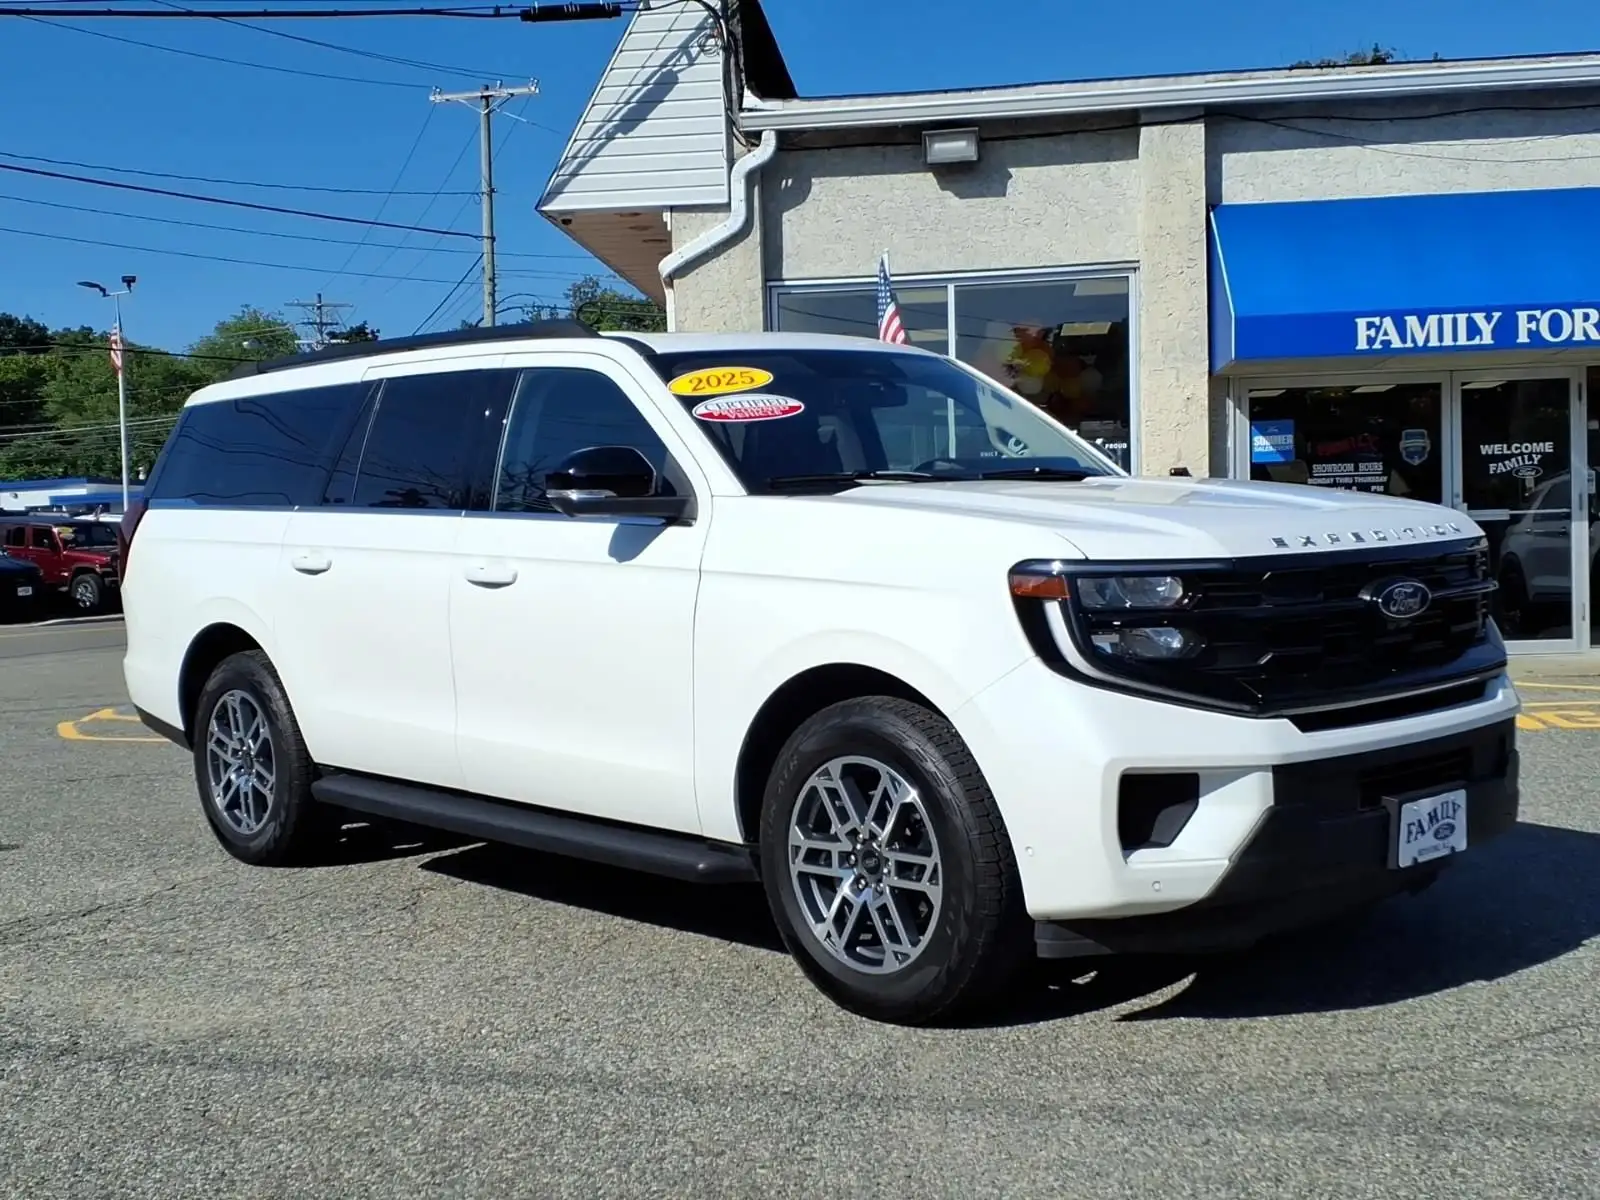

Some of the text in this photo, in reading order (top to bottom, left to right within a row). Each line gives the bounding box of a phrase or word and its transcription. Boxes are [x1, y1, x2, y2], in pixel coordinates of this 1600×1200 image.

[1354, 312, 1502, 350] FAMILY
[689, 371, 755, 392] 2025
[704, 398, 789, 411] CERTIFIED
[1480, 442, 1554, 455] WELCOME
[1312, 461, 1383, 473] SHOWROOM HOURS
[1488, 454, 1542, 475] FAMILY
[1270, 522, 1462, 548] EXPEDITION
[1405, 800, 1463, 844] FAMILY
